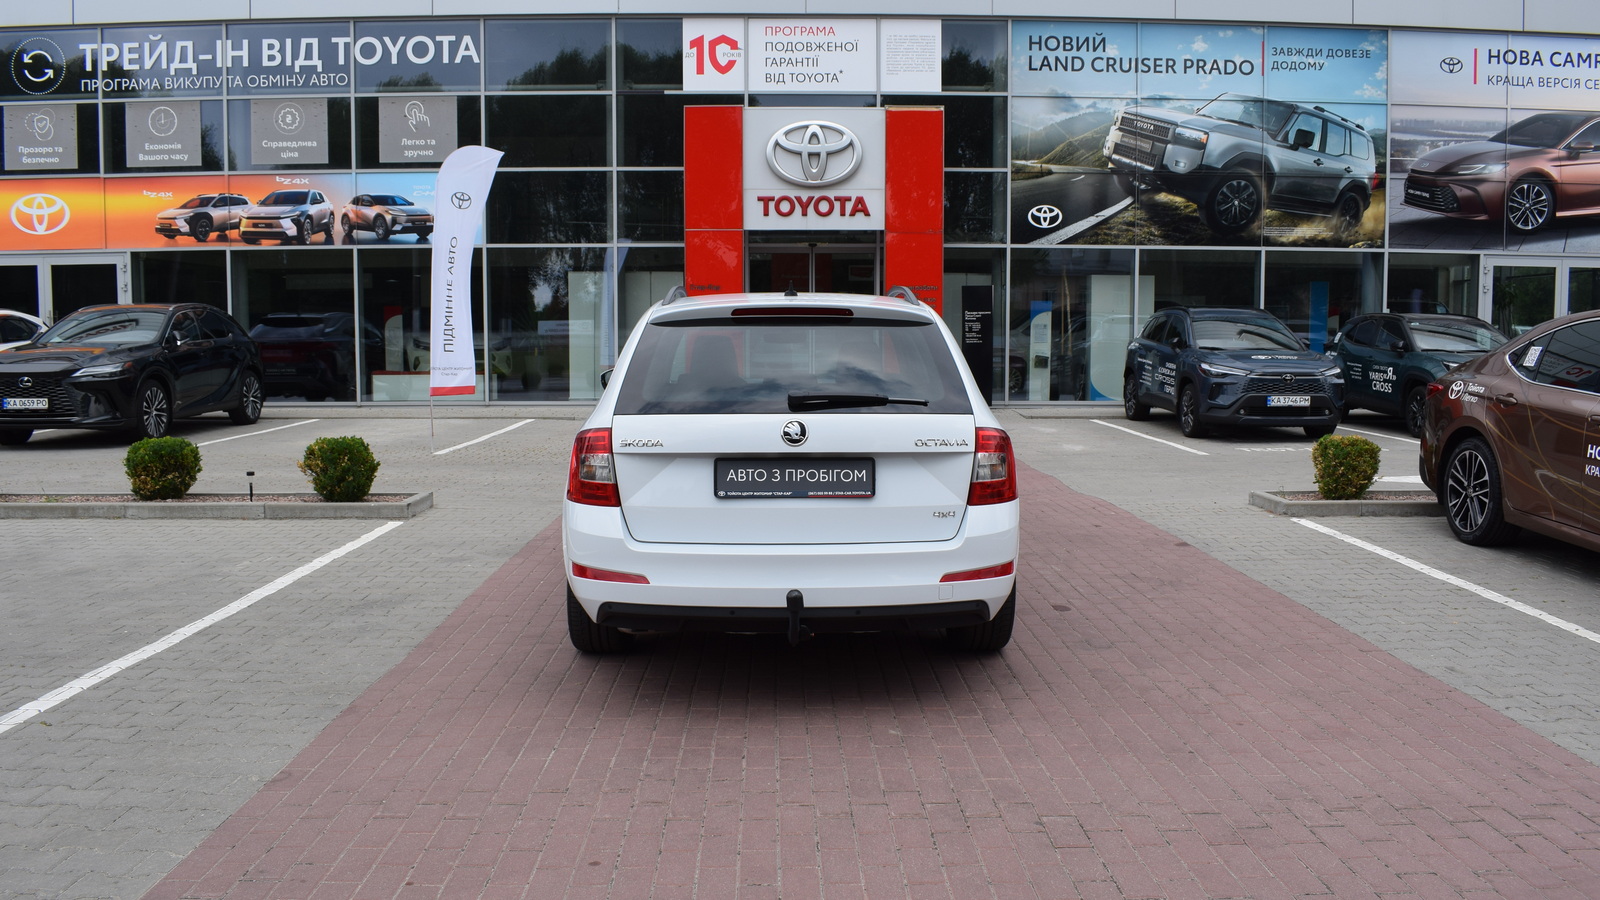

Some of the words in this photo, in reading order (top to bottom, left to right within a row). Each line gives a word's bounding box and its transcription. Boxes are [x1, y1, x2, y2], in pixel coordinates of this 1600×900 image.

[765, 26, 836, 36] ПРОГРАМА
[765, 39, 859, 53] ПОДОВЖЕНОЇ
[1028, 33, 1106, 52] НОВИЙ
[79, 34, 249, 75] ТРЕЙД-ІН
[262, 38, 322, 72] ВІД
[331, 35, 481, 65] TOYOTA
[1271, 46, 1323, 58] ЗАВЖДИ
[1326, 48, 1371, 59] ДОВЕЗЕ
[1488, 49, 1544, 66] НОВА
[765, 55, 819, 67] ГАРАНТІЇ
[1028, 56, 1085, 72] LAND
[1091, 57, 1177, 74] CRUISER
[1183, 58, 1255, 75] PRADO
[1271, 61, 1325, 71] ДОДОМУ
[81, 77, 161, 91] ПРОГРАМА
[164, 76, 223, 89] ВИКУПУ
[226, 76, 243, 88] ТА
[246, 74, 306, 88] ОБМІНУ
[309, 73, 348, 86] АВТО
[765, 73, 786, 84] ВІД
[1487, 75, 1534, 88] КРАЩА
[1538, 77, 1581, 88] ВЕРСІЯ
[1133, 121, 1154, 131] TOYOTA
[144, 142, 182, 151] Економія
[262, 140, 317, 148] Справедлива
[401, 138, 425, 147] Легко
[18, 146, 53, 154] Прозоро
[280, 150, 299, 158] ціна
[403, 149, 434, 157] зручно
[22, 156, 60, 164] безпечно
[138, 153, 169, 161] Вашого
[171, 153, 189, 161] часу
[757, 195, 871, 217] TOYOTA
[447, 236, 458, 276] АВТО
[443, 279, 456, 353] ПІДМІННЕ
[1154, 373, 1175, 385] CROSS
[1369, 371, 1383, 381] YARIS
[1372, 381, 1393, 393] CROSS
[914, 438, 969, 448] OCTAVIA
[726, 469, 767, 482] АВТО
[785, 469, 866, 482] ПРОБІГОМ
